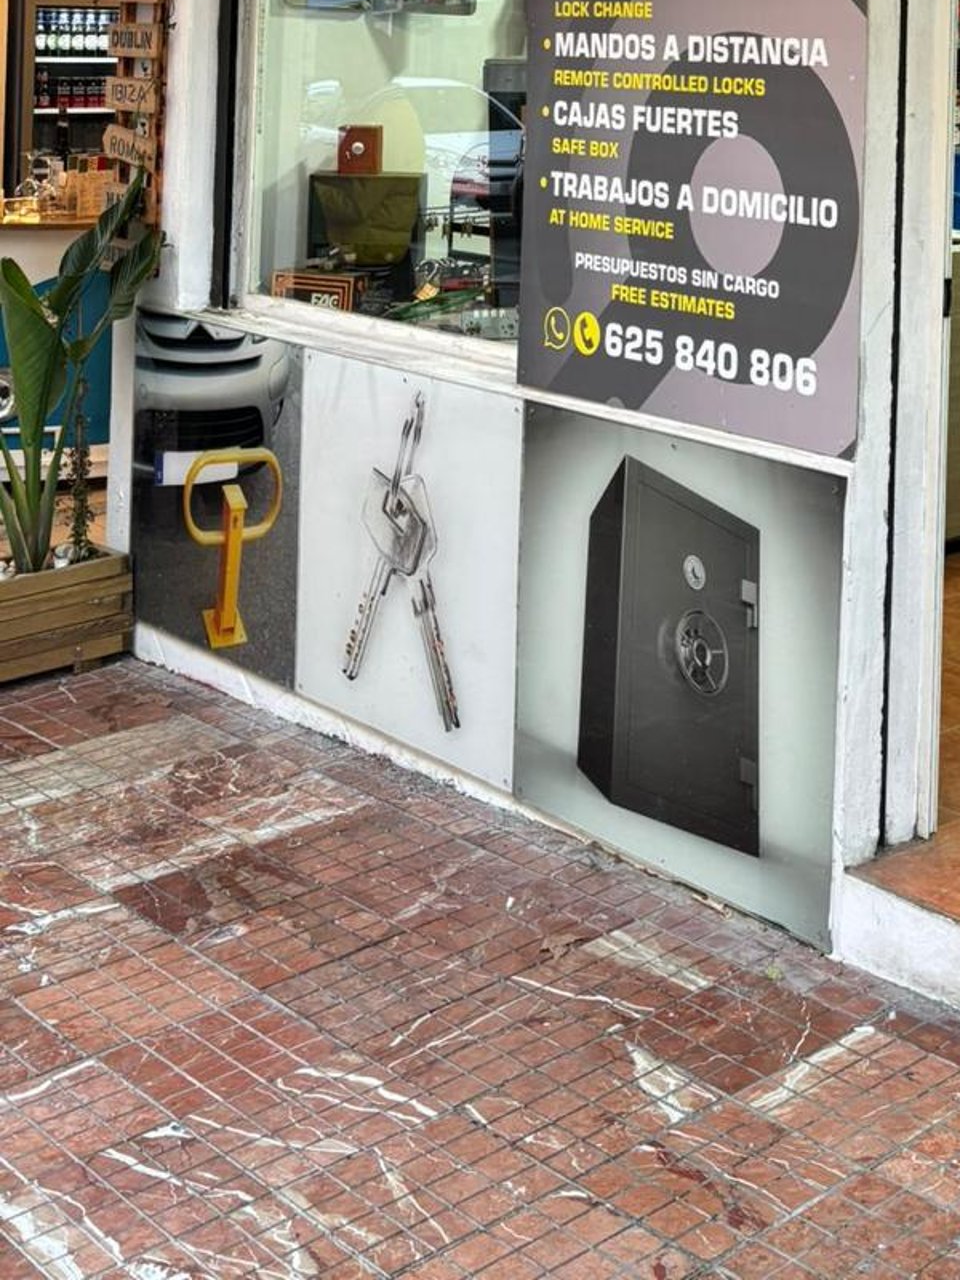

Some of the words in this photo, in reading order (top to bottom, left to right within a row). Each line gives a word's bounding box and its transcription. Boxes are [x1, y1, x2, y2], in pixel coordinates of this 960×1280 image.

[555, 1, 589, 17] LOCK
[594, 1, 653, 19] CHANGE
[112, 29, 153, 50] DUBLIN
[555, 32, 655, 61] MANDOS
[663, 35, 680, 61] A
[687, 36, 829, 67] DISTANCIA
[112, 83, 147, 104] IBIZA
[554, 69, 609, 89] REMOTE
[613, 71, 708, 93] CONTROLLED
[713, 75, 766, 96] LOCKS
[553, 100, 626, 130] CAJAS
[632, 105, 739, 139] FUERTES
[552, 137, 586, 156] SAFE
[590, 140, 619, 159] BOX
[551, 172, 670, 209] TRABAJOS
[676, 184, 694, 211] A
[702, 186, 839, 229] DOMICILIO
[549, 210, 566, 225] AT
[569, 211, 610, 233] HOME
[614, 216, 674, 239] SERVICE
[575, 252, 687, 285] PRESUPUESTOS
[691, 269, 718, 289] SIN
[723, 274, 780, 299] CARGO
[611, 283, 647, 305] FREE
[650, 290, 735, 320] ESTIMATES
[604, 321, 664, 366] 625
[674, 335, 738, 380] 840
[749, 348, 817, 396] 806
